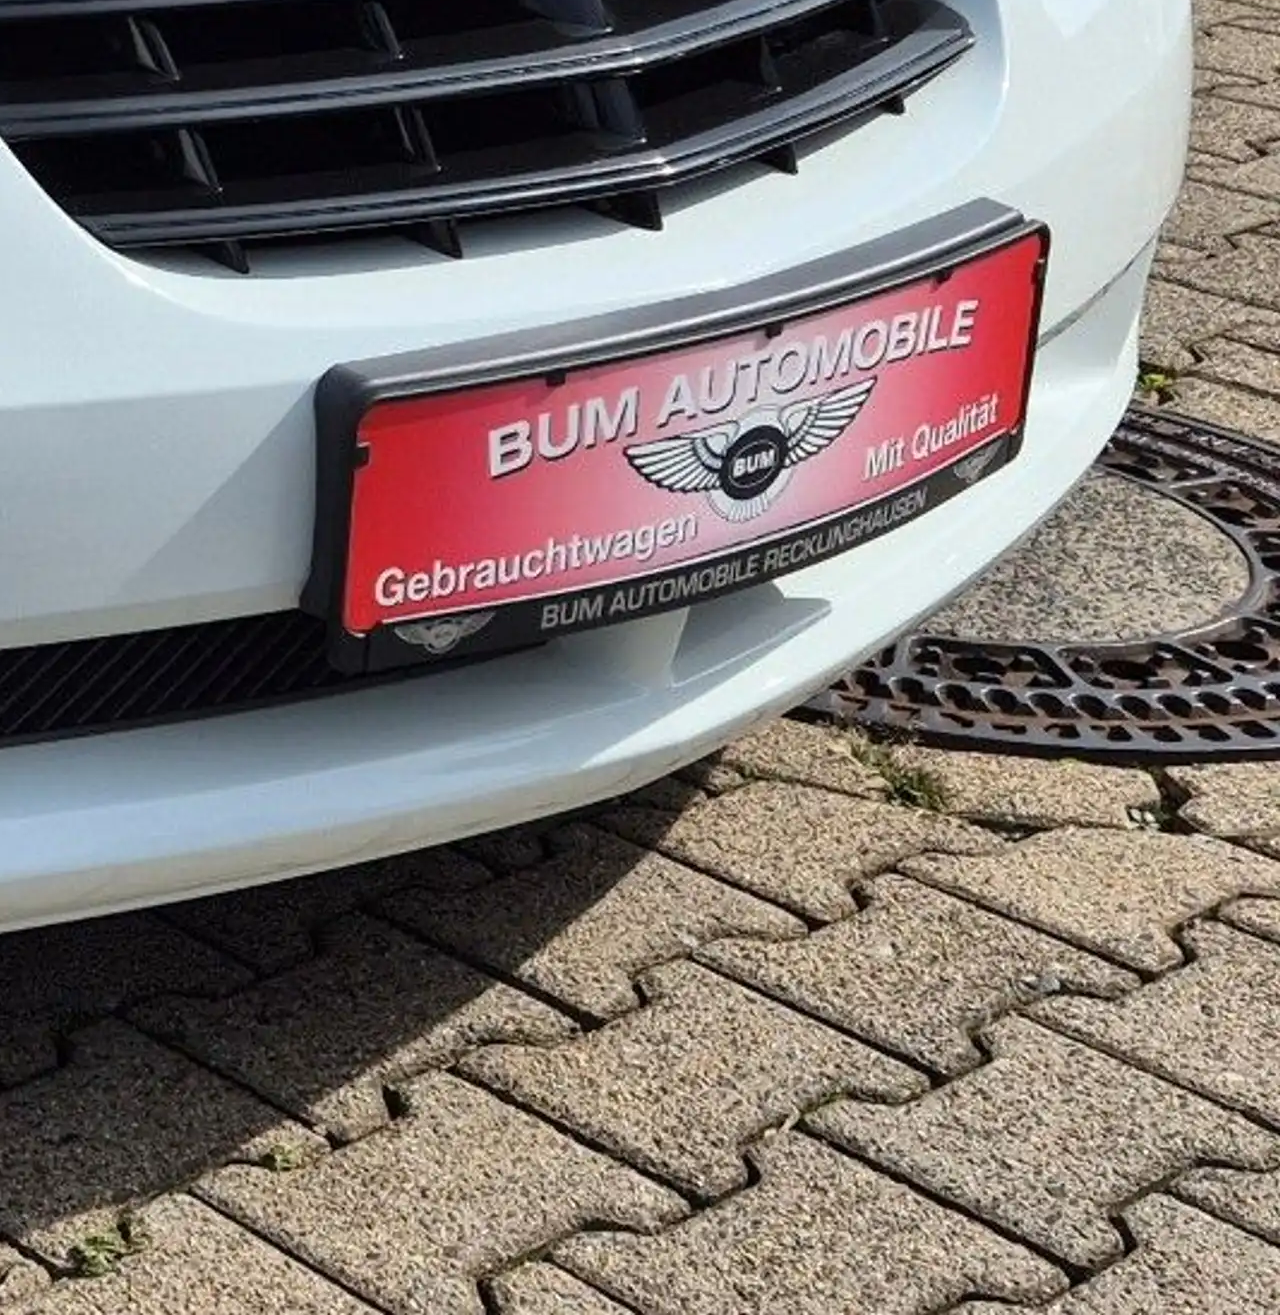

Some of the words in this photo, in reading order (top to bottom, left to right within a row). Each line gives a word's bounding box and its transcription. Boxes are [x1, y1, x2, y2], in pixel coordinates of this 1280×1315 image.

[487, 386, 639, 479] BUM
[655, 299, 979, 428] AUTOMOBILE
[732, 447, 776, 479] BUM
[862, 435, 906, 482] Mit
[911, 391, 1000, 460] Qualität
[373, 513, 698, 607] Gebrauchtwagen
[540, 596, 604, 630] BUM
[608, 552, 761, 616] AUTOMOBILE
[762, 486, 929, 573] RECKLINGHAUSEN
